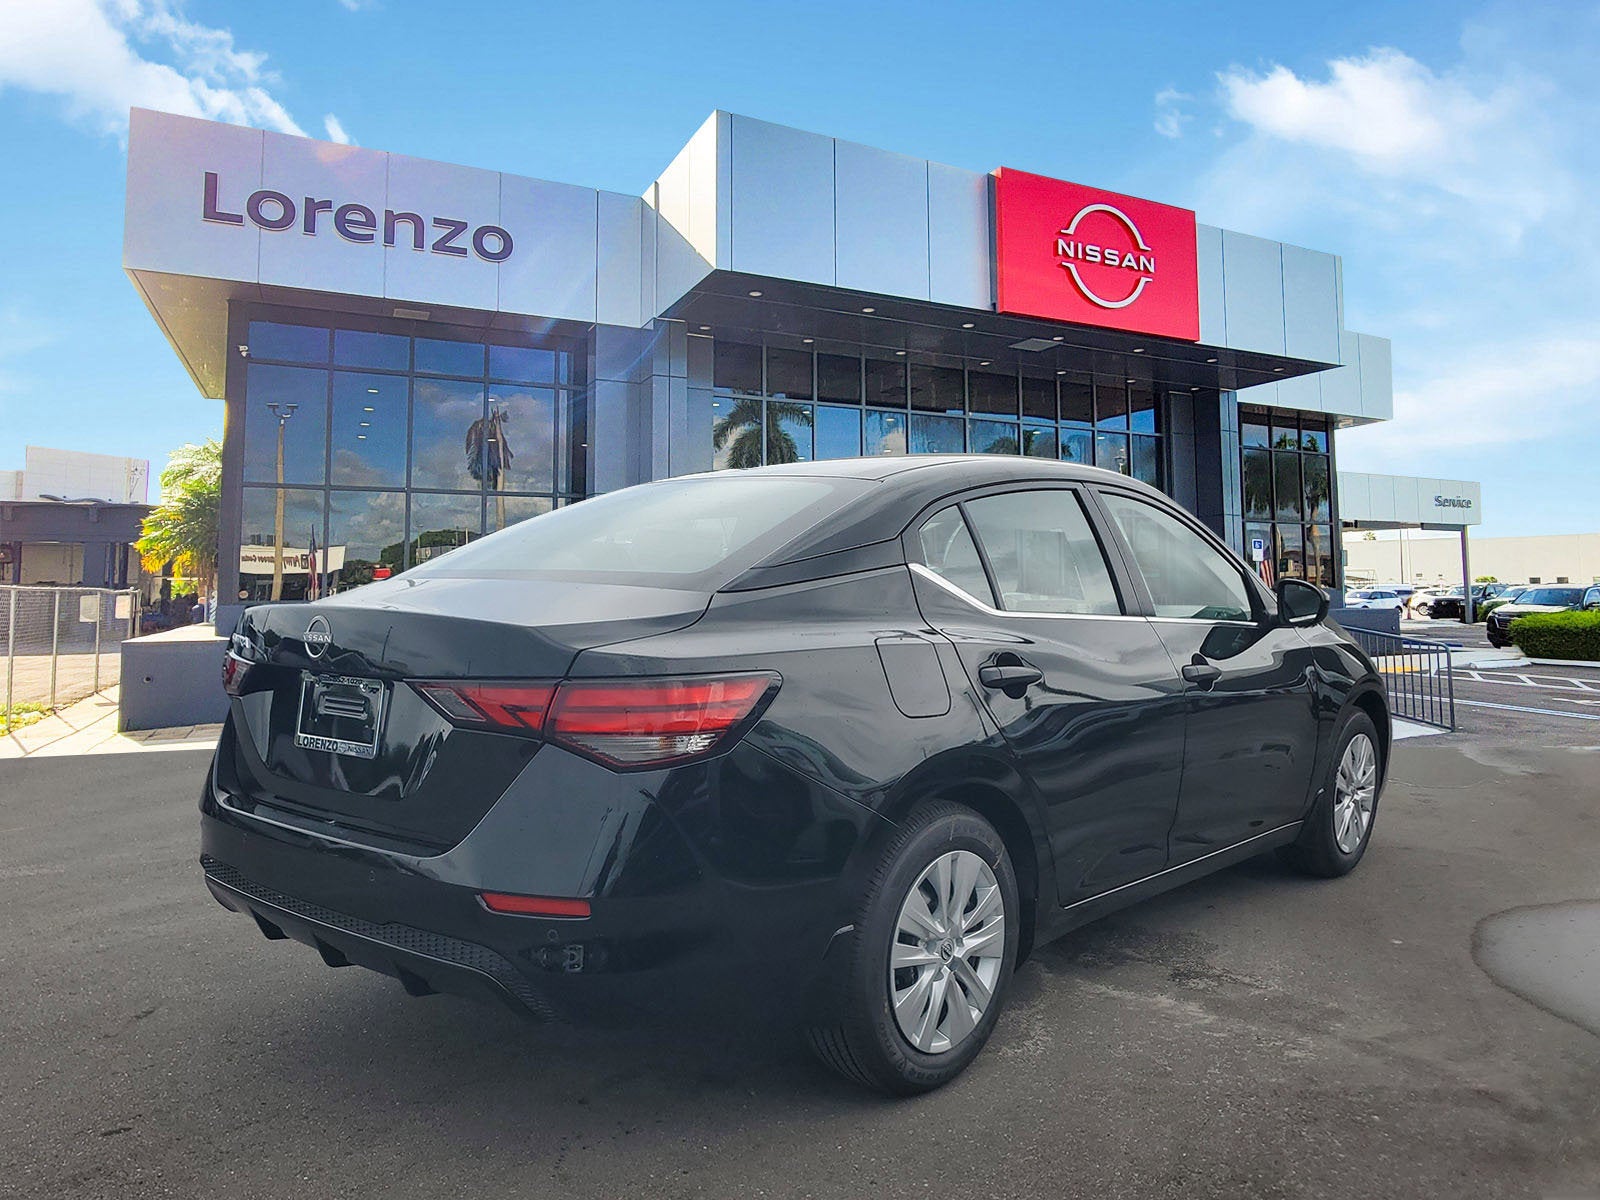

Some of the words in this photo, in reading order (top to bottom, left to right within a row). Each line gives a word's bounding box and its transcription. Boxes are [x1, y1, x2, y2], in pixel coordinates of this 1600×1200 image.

[203, 171, 514, 262] Lorenzo
[1057, 238, 1155, 273] NISSAN
[1434, 495, 1472, 509] Service
[298, 735, 339, 752] LORENZO
